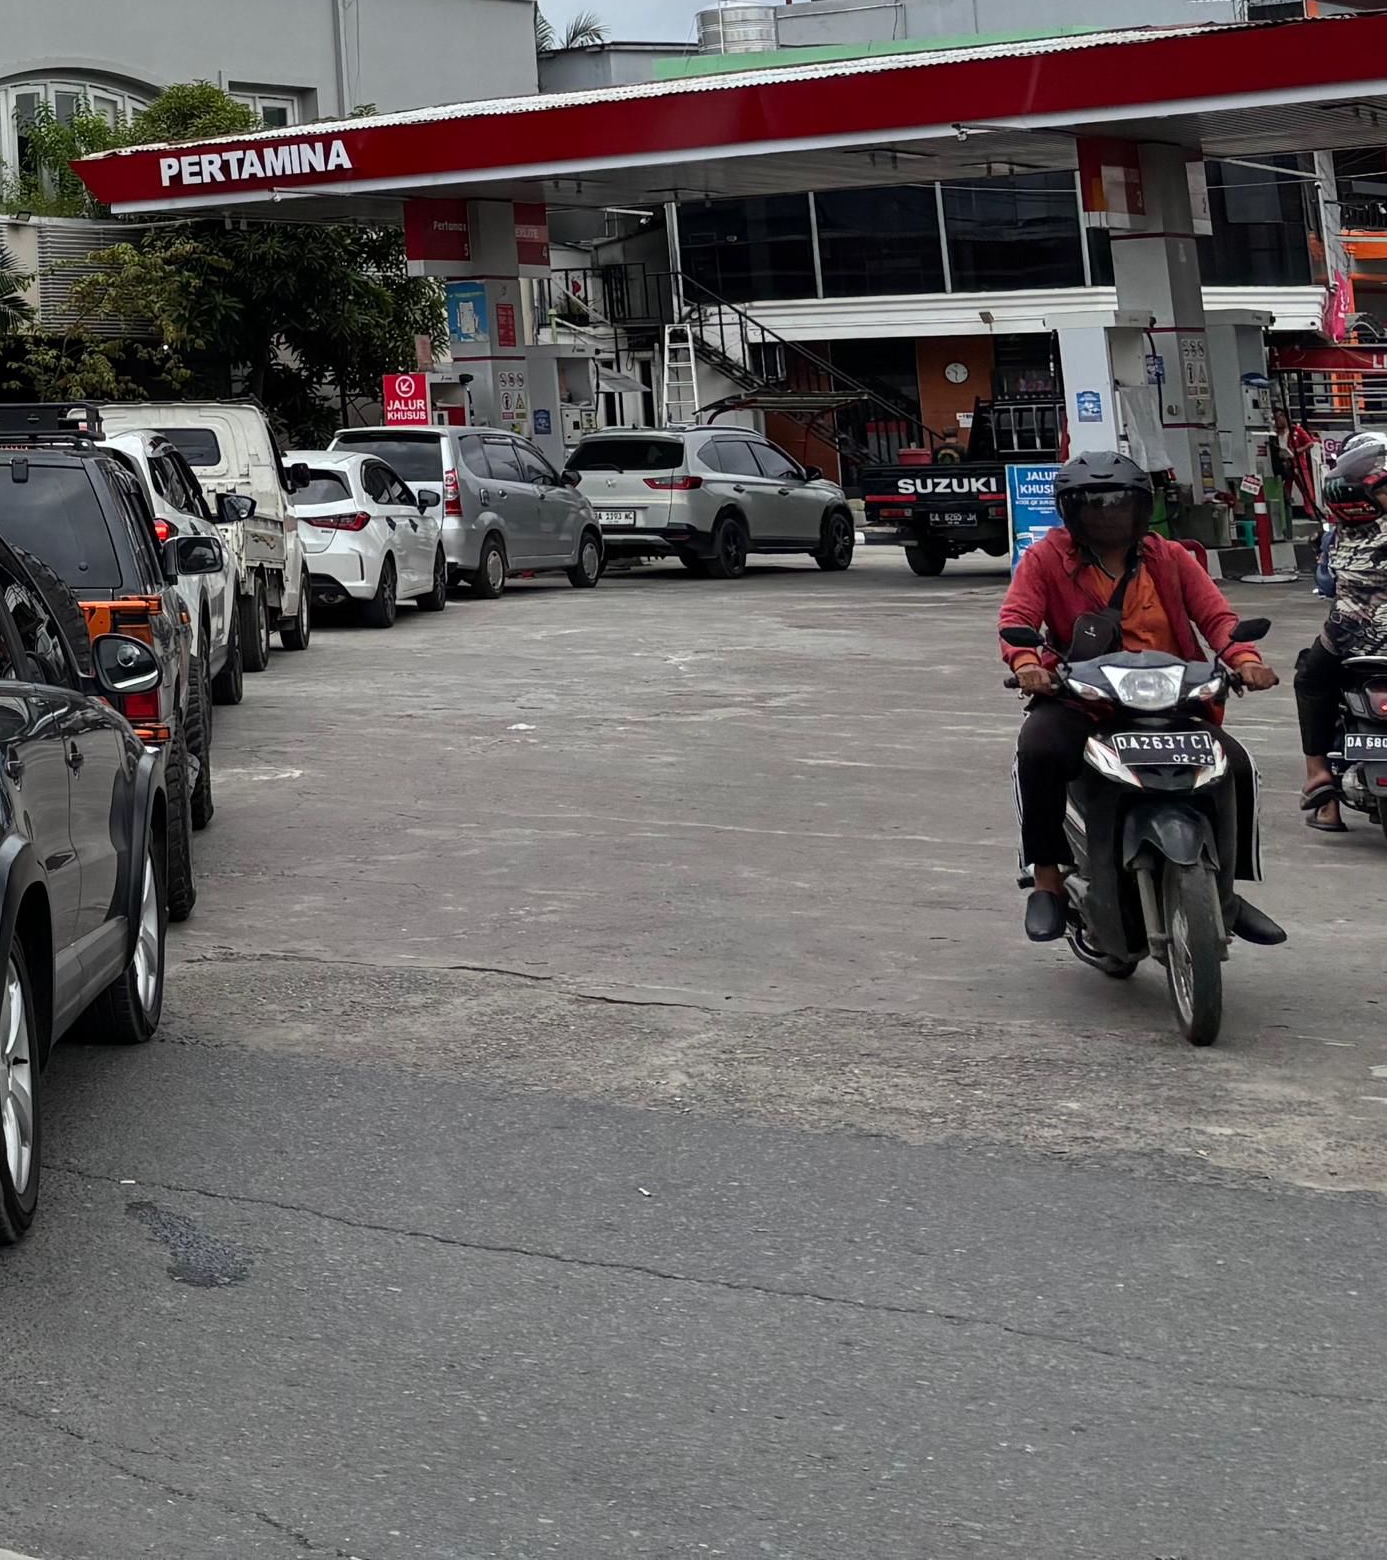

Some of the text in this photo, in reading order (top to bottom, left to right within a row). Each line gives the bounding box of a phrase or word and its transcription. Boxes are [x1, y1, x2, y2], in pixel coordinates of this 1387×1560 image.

[159, 139, 353, 187] PERTAMINA
[387, 399, 425, 410] JALUR
[387, 410, 426, 420] KHUSUS
[897, 477, 998, 494] SUZUKI
[1116, 737, 1140, 749] DA
[1140, 735, 1185, 750] 2637
[1347, 736, 1362, 747] DA
